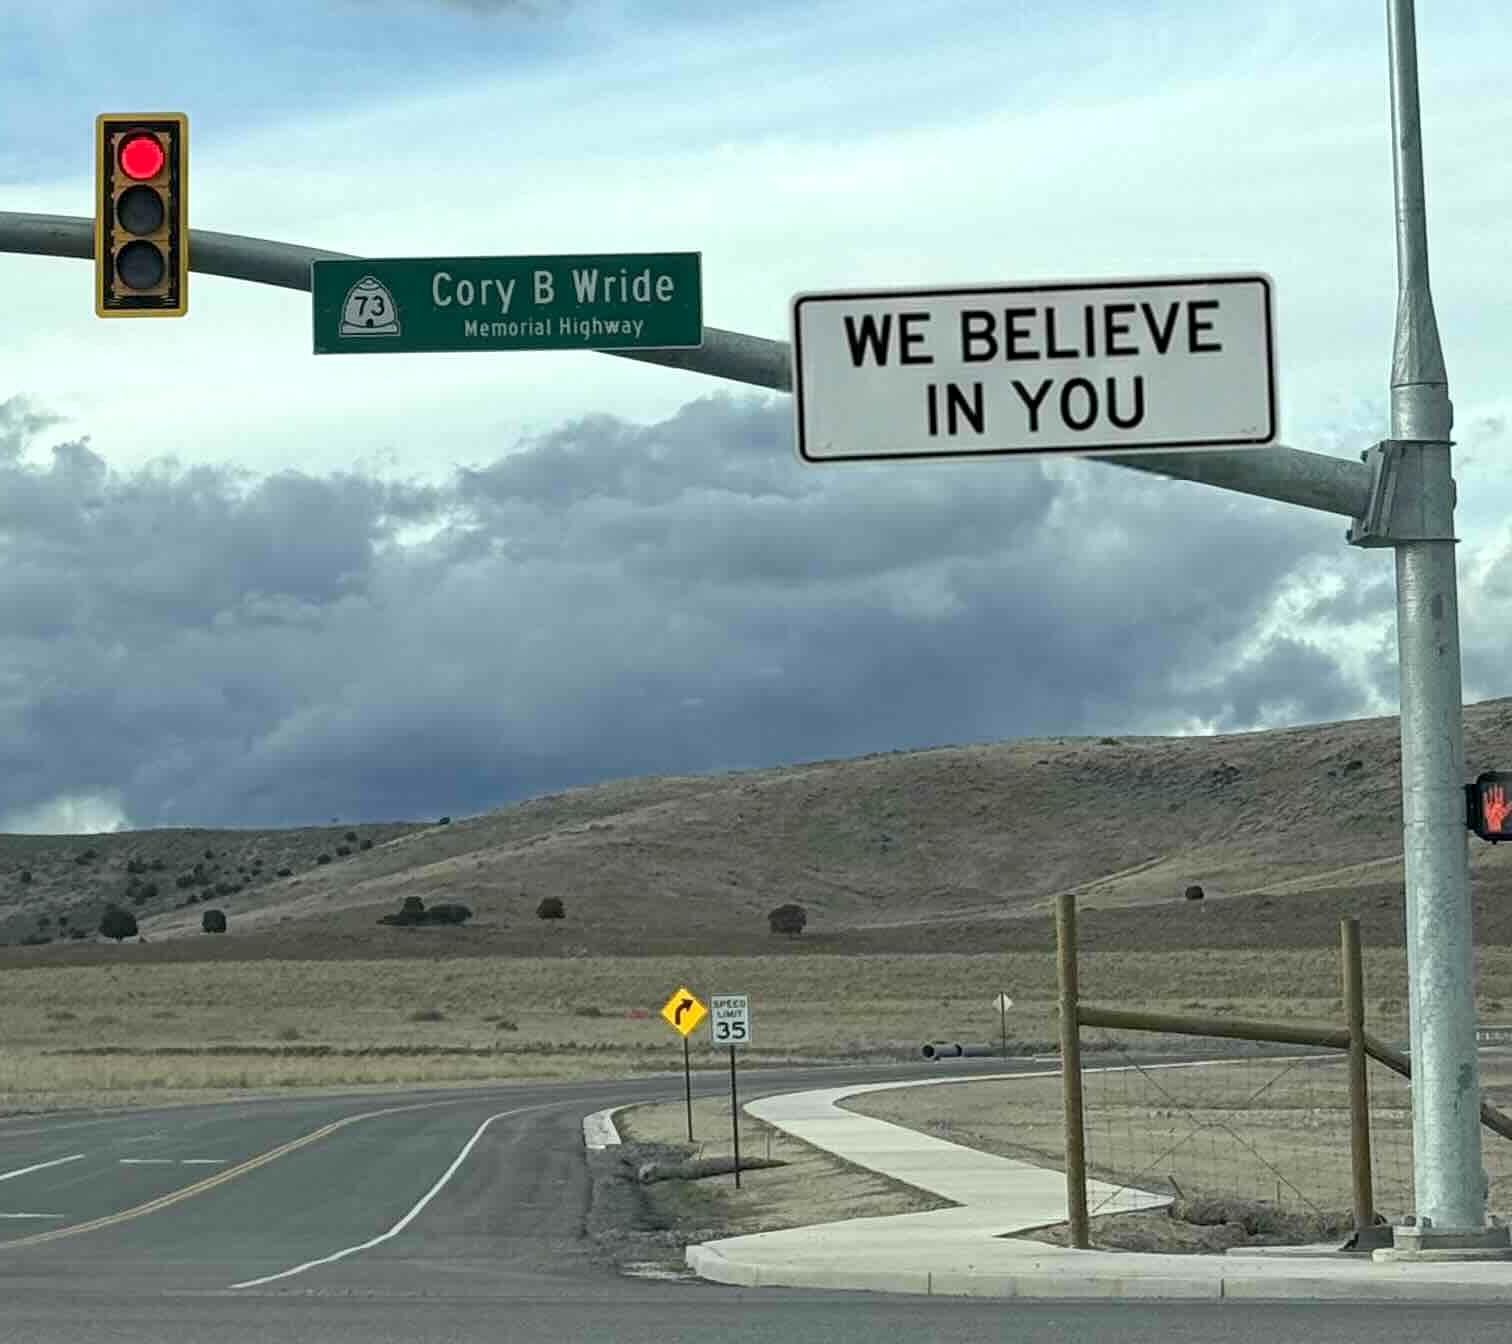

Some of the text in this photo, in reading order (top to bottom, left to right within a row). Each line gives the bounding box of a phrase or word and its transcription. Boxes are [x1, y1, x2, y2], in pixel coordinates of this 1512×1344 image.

[354, 295, 385, 318] 73
[432, 269, 675, 313] Cory B Wride
[464, 317, 644, 341] Memorial Highway
[844, 300, 1222, 367] WE BELIEVE
[928, 376, 1145, 436] IN YOU
[716, 1021, 746, 1039] 35
